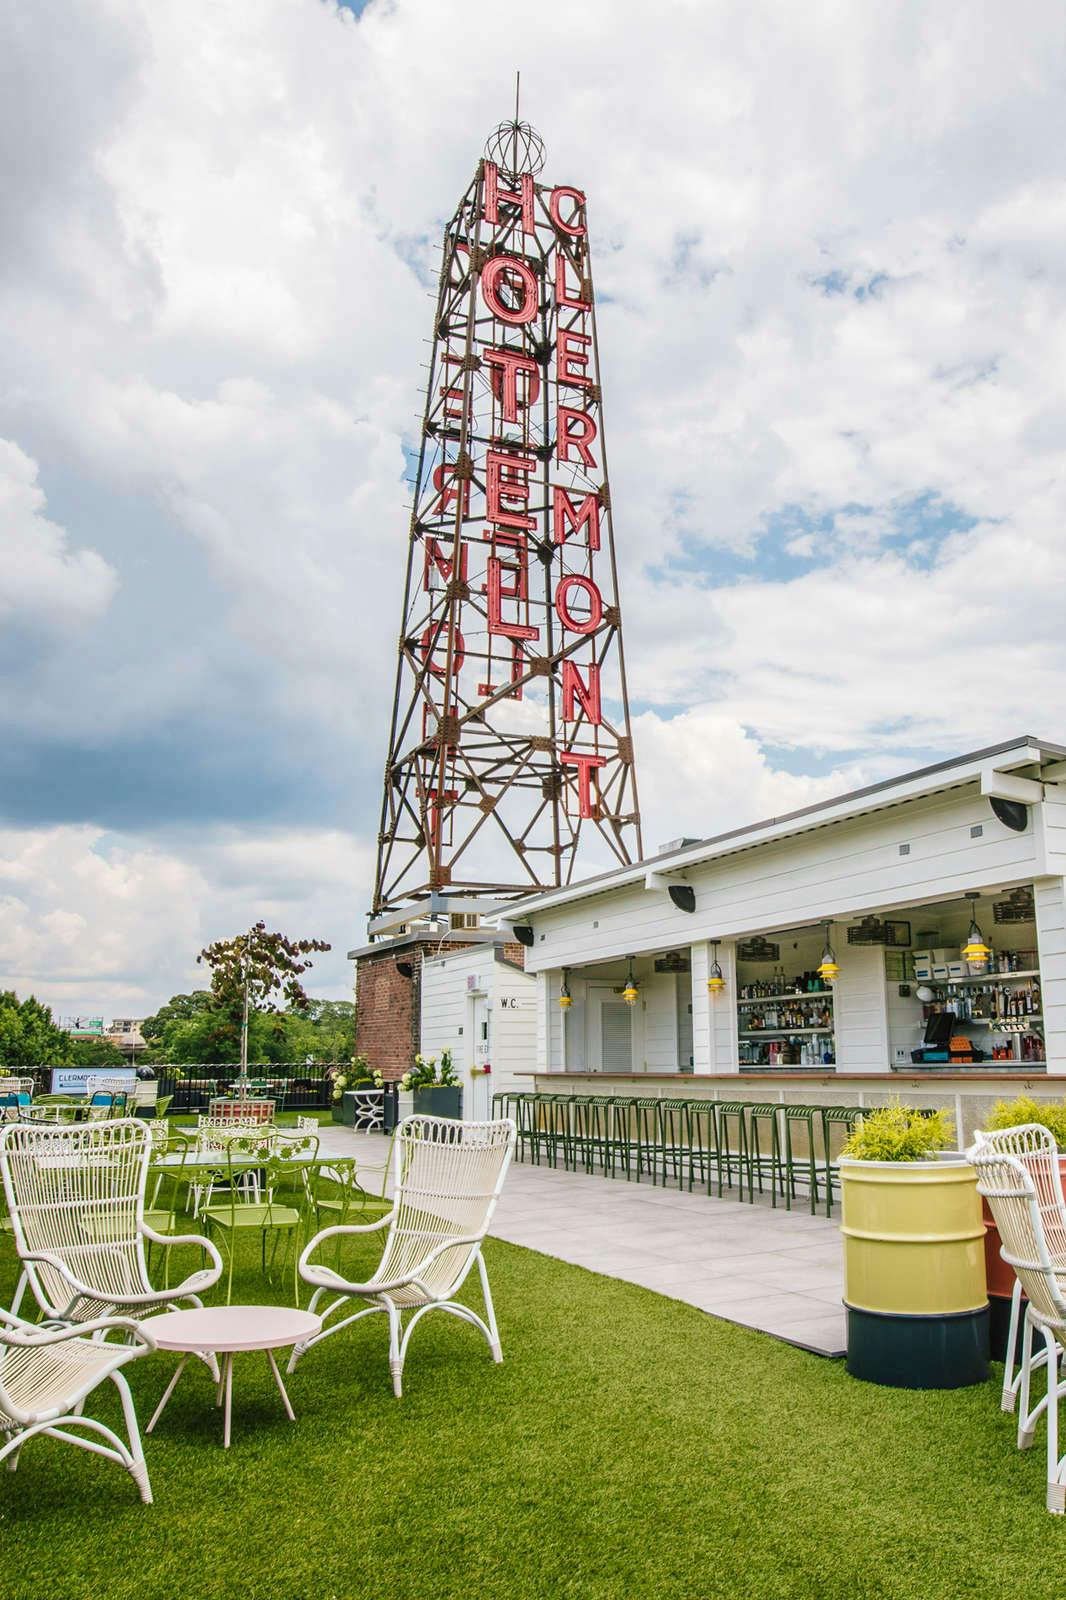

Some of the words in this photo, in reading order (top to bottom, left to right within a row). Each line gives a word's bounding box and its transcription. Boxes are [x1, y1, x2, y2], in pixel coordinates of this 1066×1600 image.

[482, 160, 540, 641] HOTEL
[549, 186, 607, 819] CLERMONT
[501, 998, 519, 1008] W.C.
